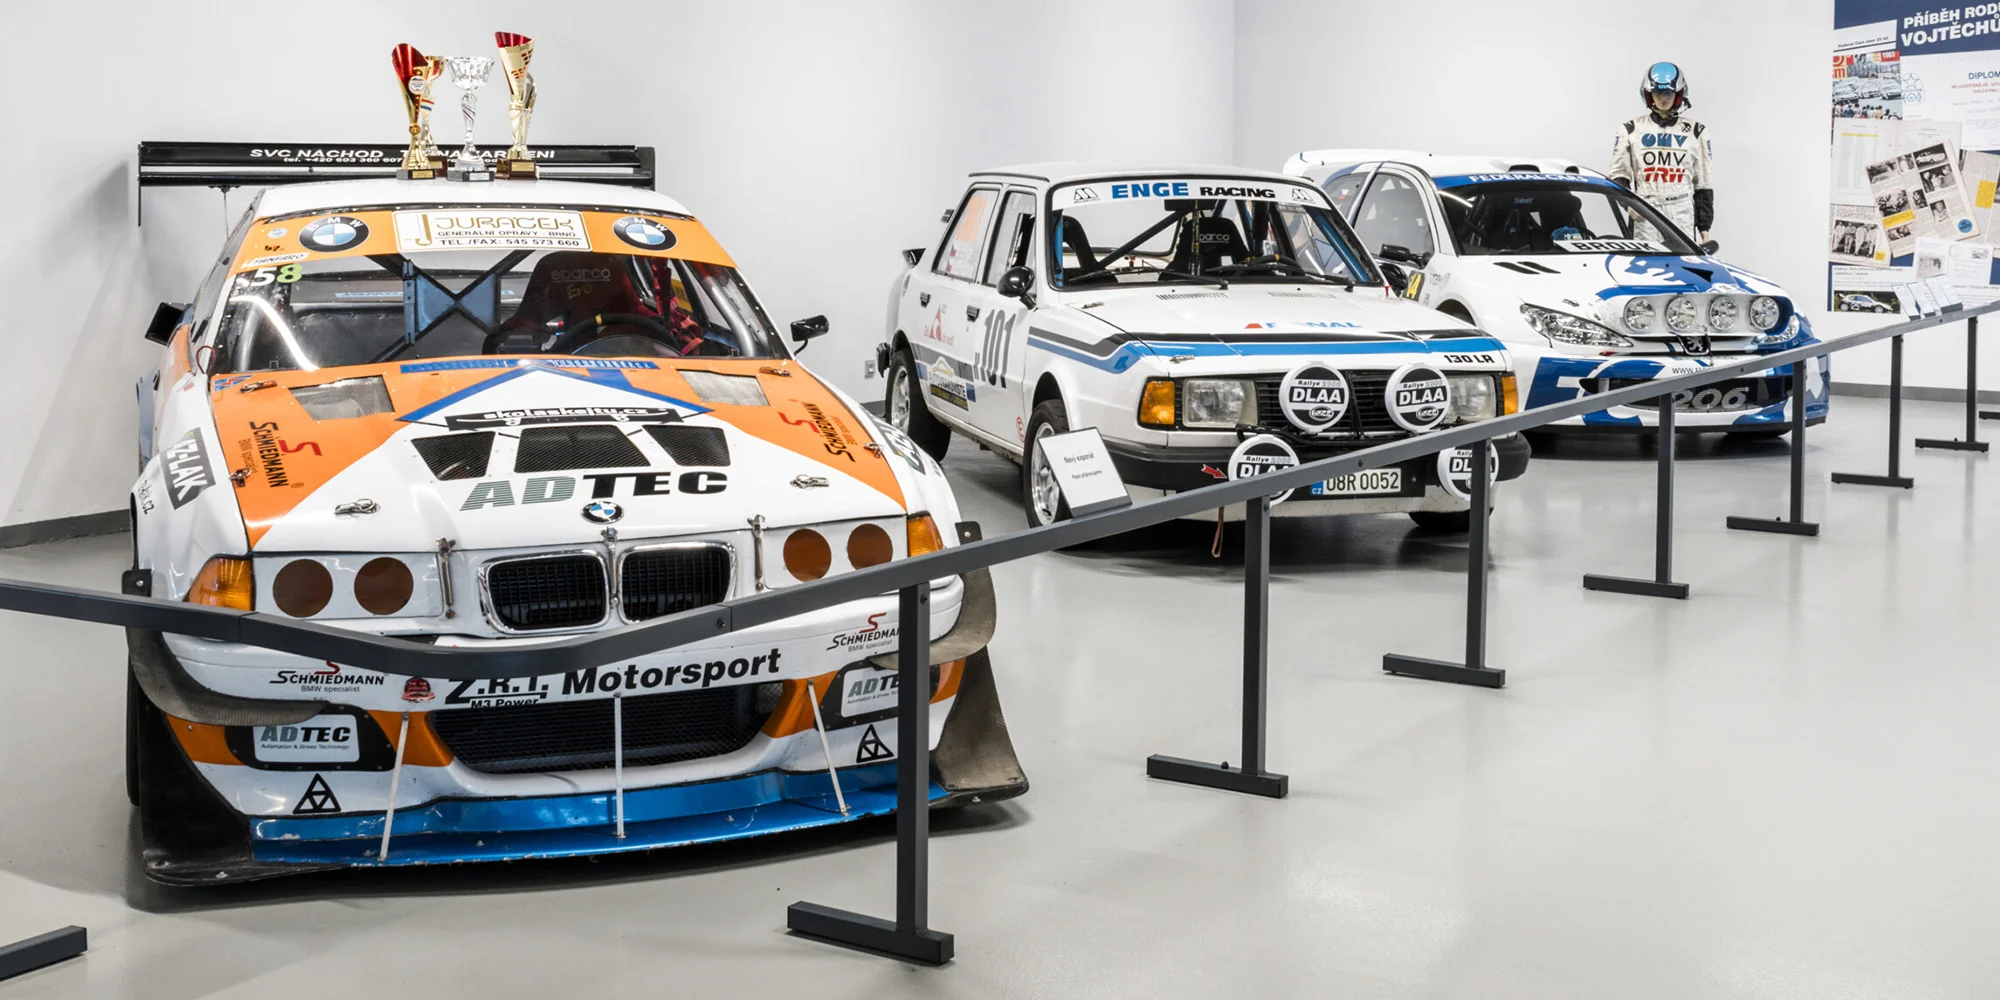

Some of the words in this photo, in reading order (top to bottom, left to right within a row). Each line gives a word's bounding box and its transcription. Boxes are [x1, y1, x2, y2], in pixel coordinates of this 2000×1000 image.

[1903, 8, 1960, 29] PŘÍBĚH
[250, 149, 291, 157] SVC
[1643, 151, 1686, 166] OMV
[1469, 173, 1544, 183] FEDERAL
[1544, 174, 1589, 183] CARS
[1643, 167, 1686, 183] TRW
[1111, 182, 1189, 199] ENGE
[1199, 186, 1276, 199] RACING
[506, 238, 528, 246] 545
[532, 239, 554, 247] 573
[558, 239, 580, 247] 660
[1198, 233, 1230, 242] parco
[1571, 241, 1659, 251] BROUK
[550, 268, 611, 281] sparco
[979, 308, 1017, 389] 101
[1443, 354, 1472, 363] 130
[1474, 355, 1496, 364] LR
[1297, 380, 1320, 388] Rallye
[1402, 381, 1424, 389] Rallye
[1292, 387, 1342, 403] DLAA
[1399, 389, 1445, 406] DLAA
[1672, 386, 1750, 409] 206
[249, 421, 289, 488] SCHMIEDMANN
[1359, 471, 1399, 489] 0052
[459, 469, 728, 512] ADTEC
[826, 628, 900, 651] SCHMIEDMA
[866, 639, 893, 651] specialist
[268, 670, 386, 686] SCHMIEDMANN
[561, 648, 781, 696] Motorsport
[301, 685, 321, 693] BMW
[324, 686, 360, 694] specialist
[470, 697, 494, 709] M3
[495, 697, 540, 708] Power
[260, 726, 352, 743] ADTEC
